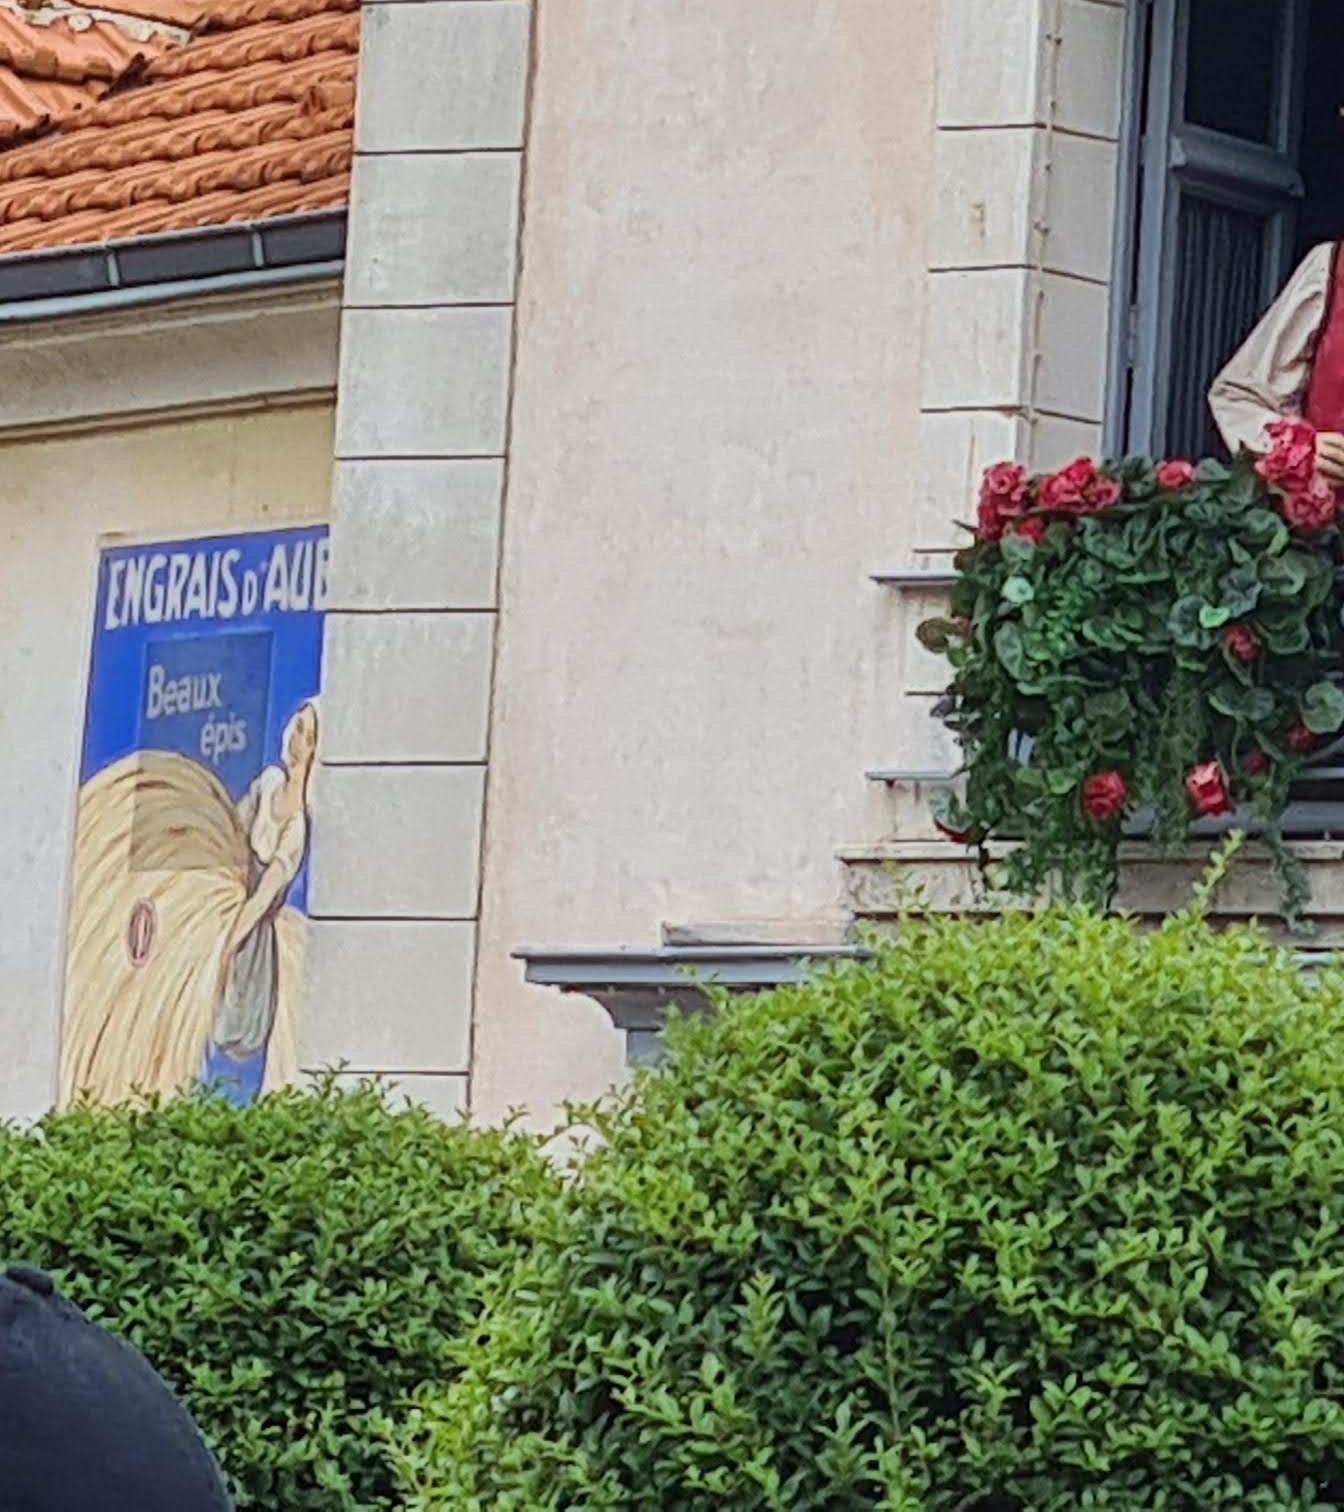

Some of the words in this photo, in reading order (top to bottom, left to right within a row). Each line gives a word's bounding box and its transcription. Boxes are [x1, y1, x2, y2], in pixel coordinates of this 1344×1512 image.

[104, 549, 241, 631] ENGRAIS
[146, 664, 223, 720] Beaux
[199, 712, 248, 765] épis
